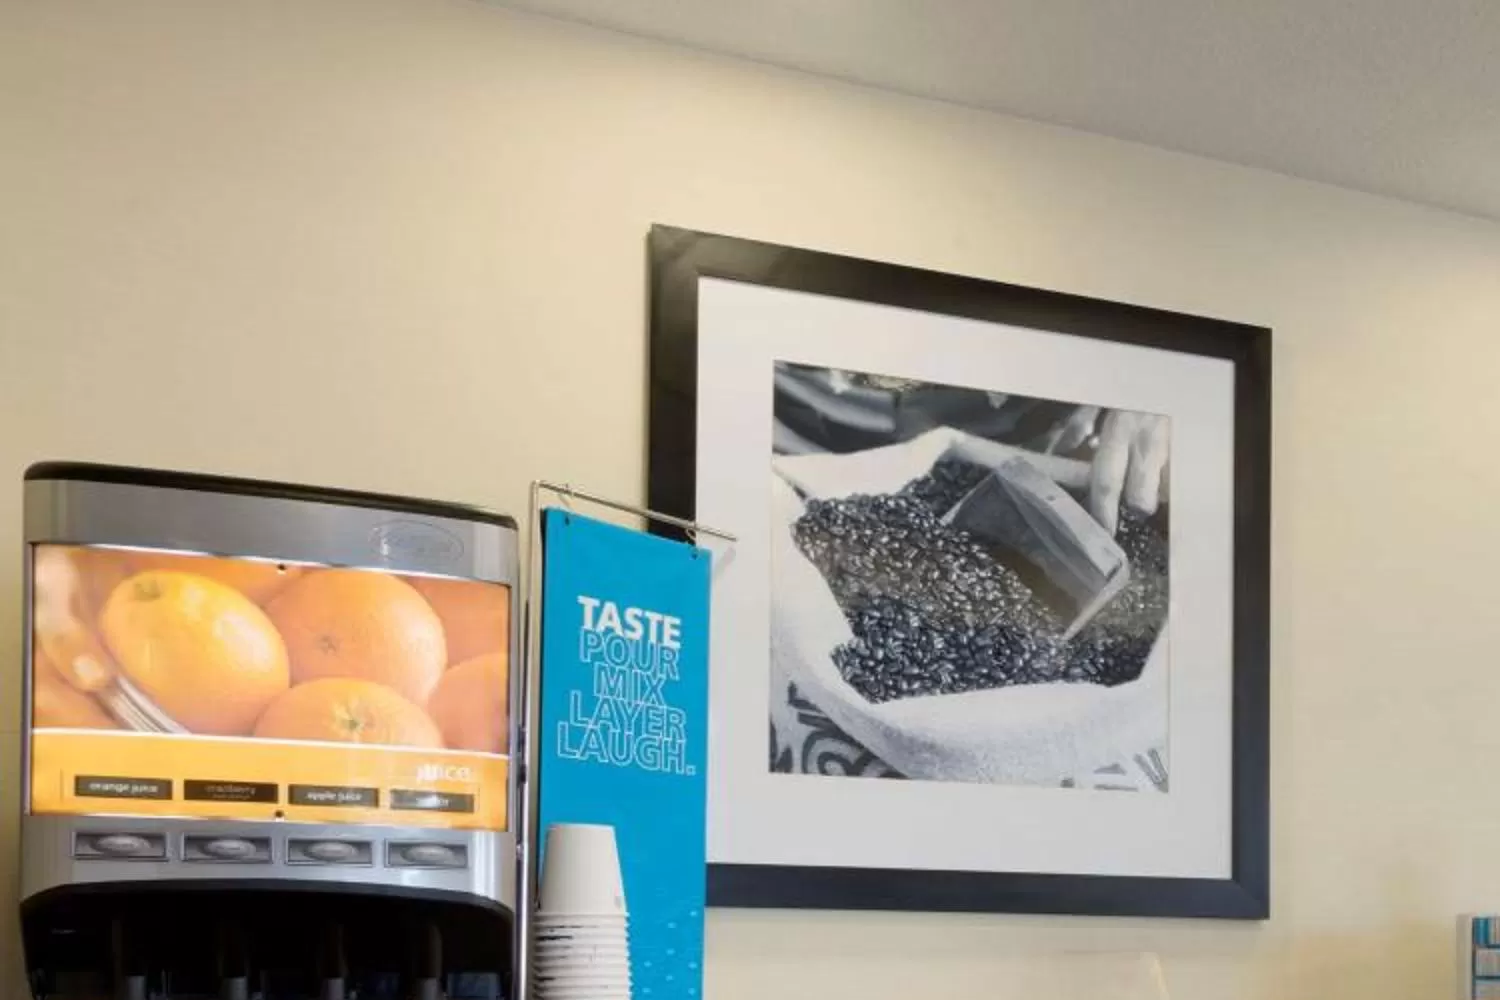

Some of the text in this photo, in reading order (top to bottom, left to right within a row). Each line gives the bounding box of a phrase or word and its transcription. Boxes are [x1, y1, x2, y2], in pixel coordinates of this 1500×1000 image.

[577, 595, 682, 649] TASTE
[579, 626, 680, 681] POUR
[593, 660, 665, 706] MIX
[569, 690, 687, 743] LAYER
[557, 721, 697, 777] LAUGH.
